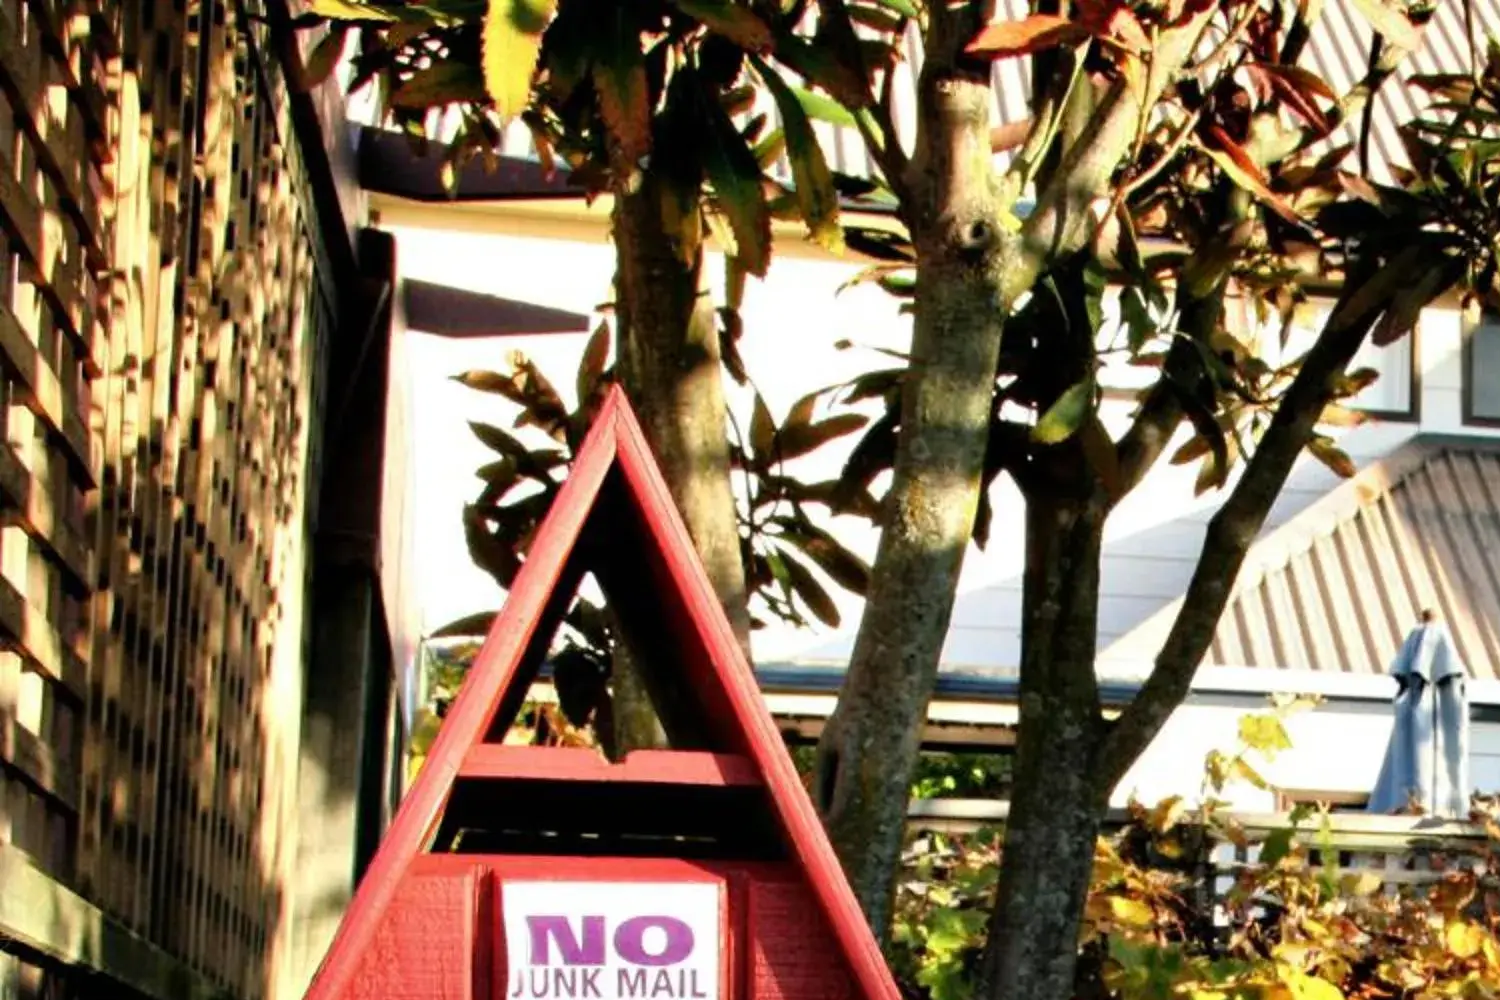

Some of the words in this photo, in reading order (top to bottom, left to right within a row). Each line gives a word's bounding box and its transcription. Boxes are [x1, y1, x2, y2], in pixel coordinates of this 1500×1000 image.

[525, 914, 696, 967] NO
[511, 967, 604, 999] JUNK
[617, 967, 707, 999] MAIL
